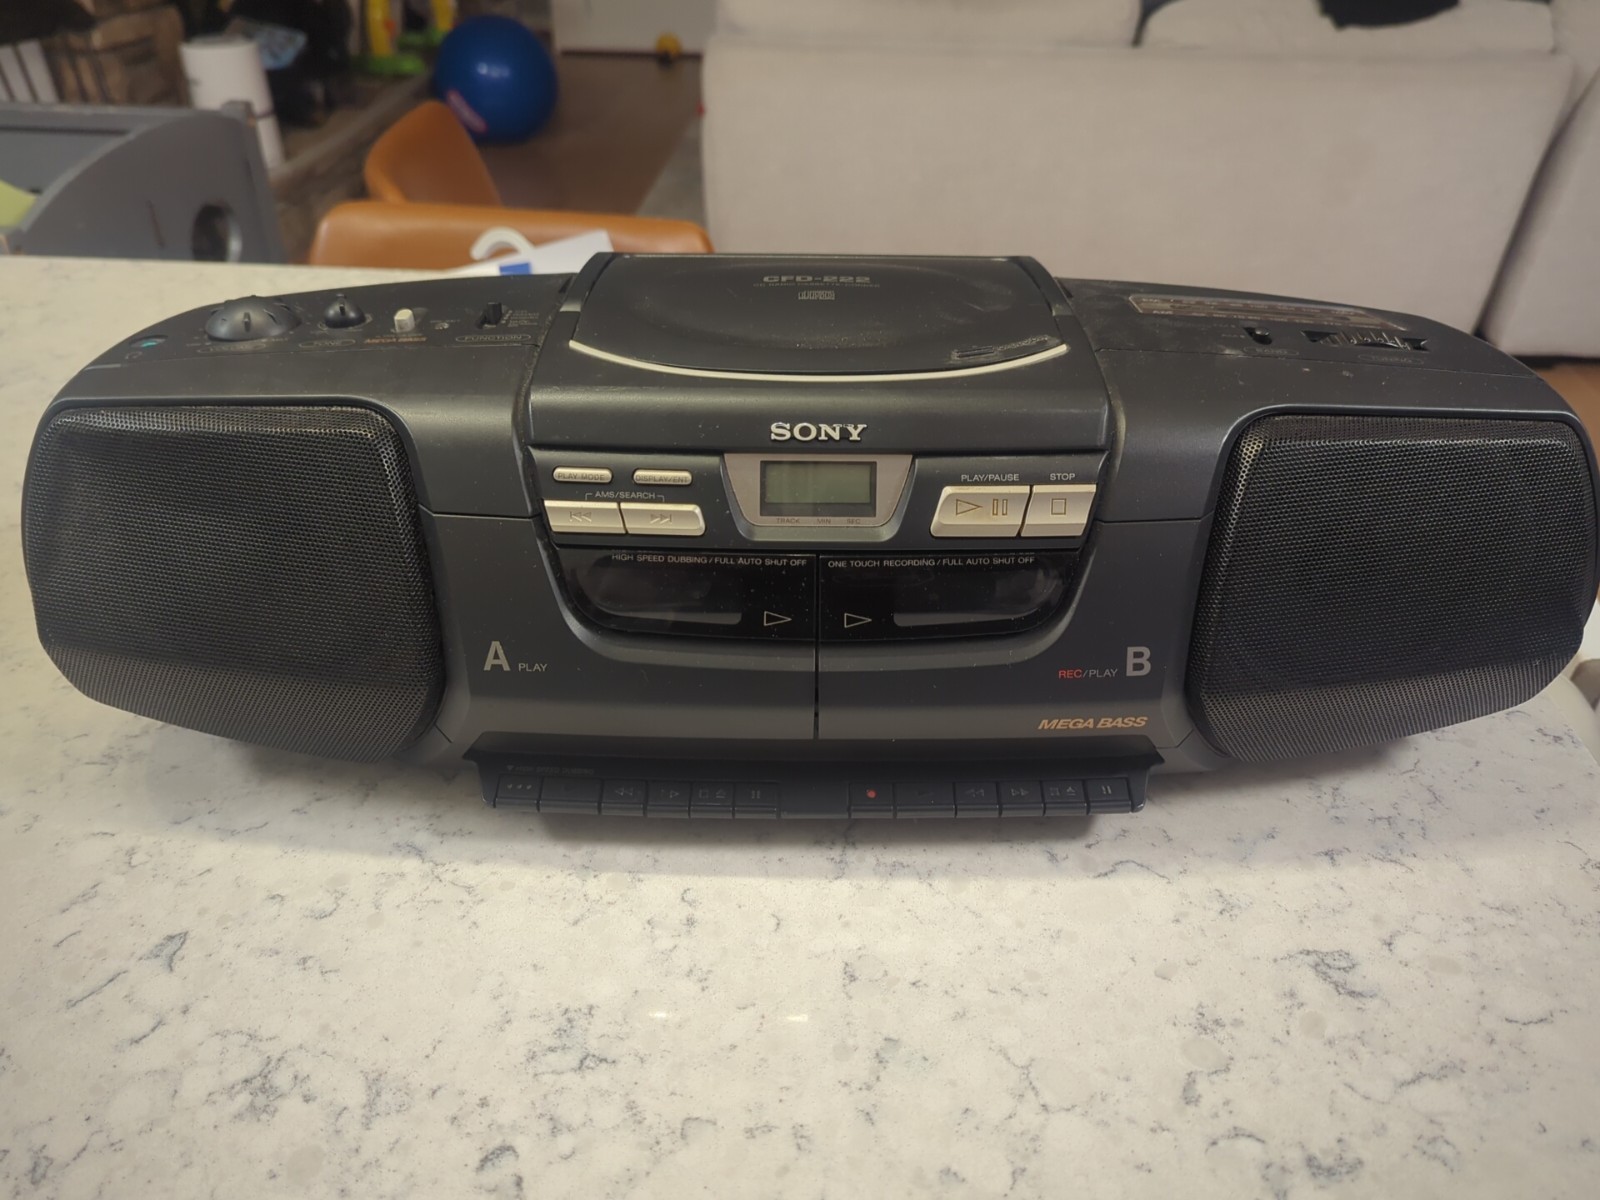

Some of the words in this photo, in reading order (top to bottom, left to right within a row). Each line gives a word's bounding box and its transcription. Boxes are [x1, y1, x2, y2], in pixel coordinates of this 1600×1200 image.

[770, 421, 868, 441] SONY
[557, 472, 577, 481] PLAY
[582, 473, 605, 481] MODE
[960, 473, 1020, 482] PLAY/PAUSE
[1050, 472, 1076, 481] STOP
[594, 491, 656, 500] AMS/SEARCH
[612, 553, 634, 561] HIGH
[636, 554, 665, 563] SPEED
[667, 555, 708, 564] DUBBING
[714, 557, 736, 565] FULL
[738, 557, 762, 566] AUTO
[764, 558, 788, 566] SHUT
[828, 560, 847, 568] ONE
[849, 560, 880, 568] TOUCH
[883, 558, 935, 567] RECORDING
[942, 558, 964, 566] FULL
[966, 557, 990, 565] AUTO
[992, 557, 1016, 565] SHUT
[1018, 556, 1035, 564] OFF
[483, 640, 511, 671] A
[518, 662, 548, 672] PLAY
[1058, 668, 1118, 679] REC/PLAY
[1125, 646, 1152, 677] B
[1038, 718, 1094, 730] MEGA
[1096, 716, 1149, 729] BASS
